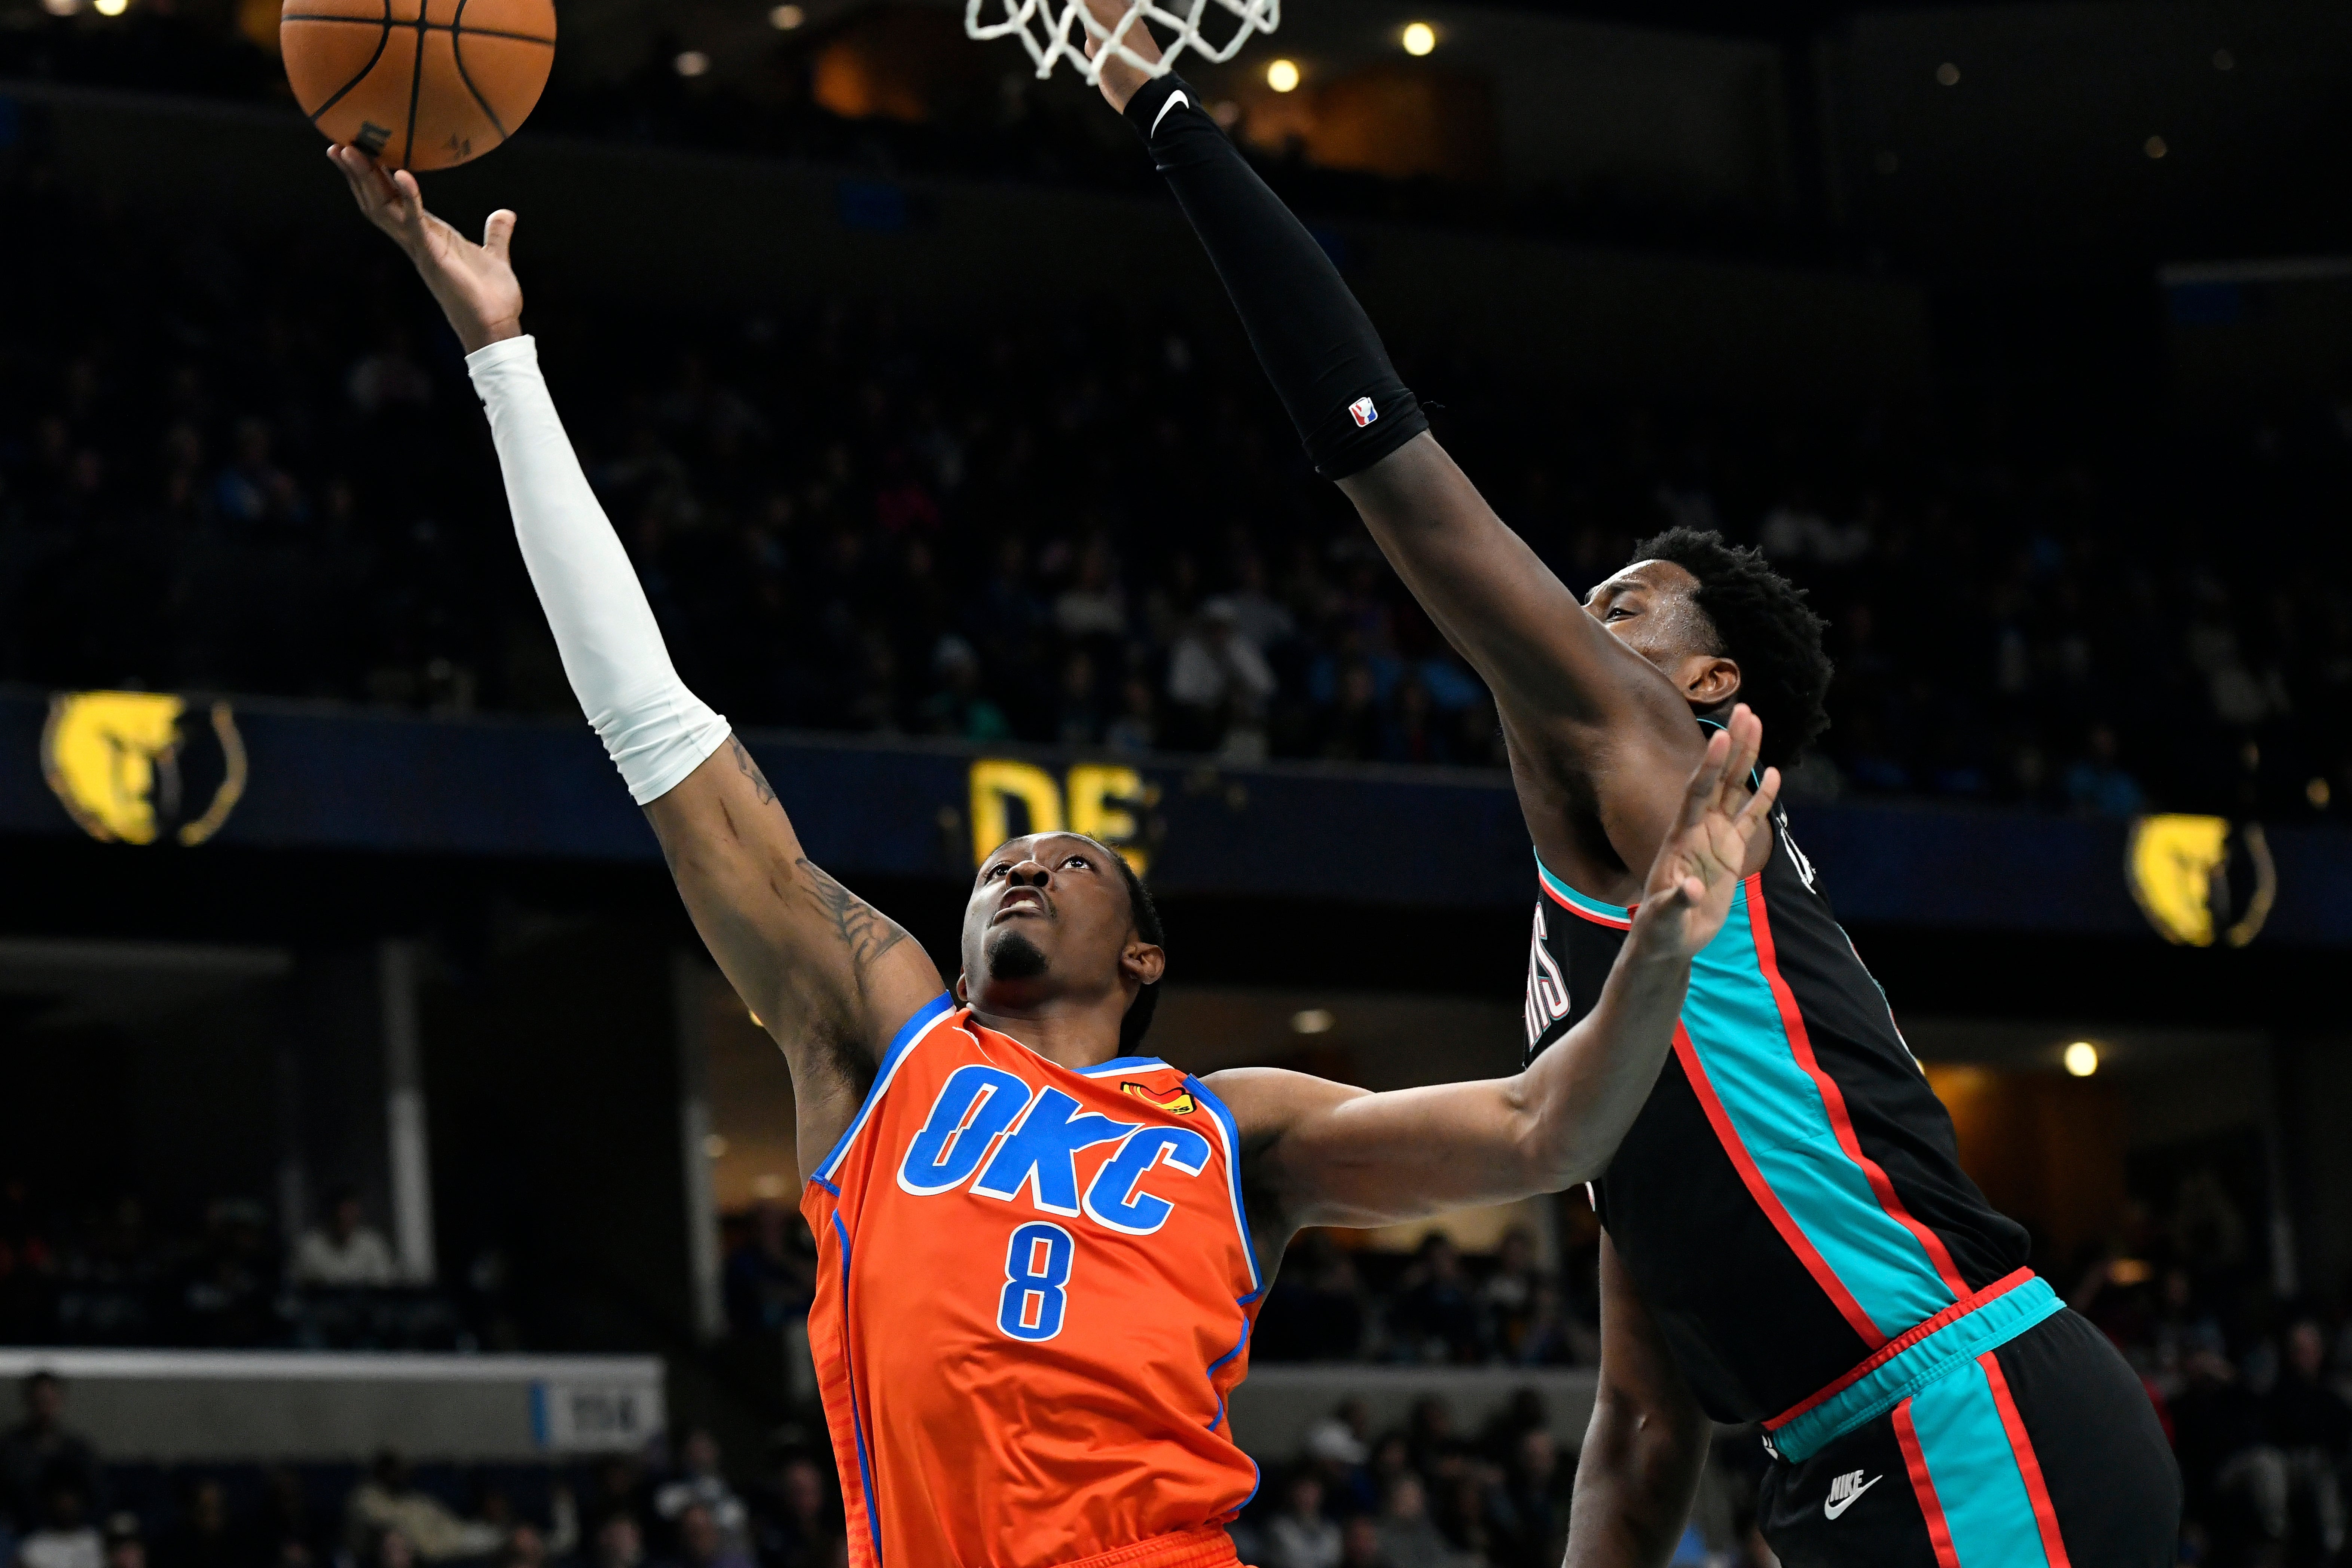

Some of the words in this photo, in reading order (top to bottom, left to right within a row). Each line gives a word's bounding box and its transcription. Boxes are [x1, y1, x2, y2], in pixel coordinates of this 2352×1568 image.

[897, 1064, 1212, 1235] OKC
[996, 1220, 1075, 1342] 8
[1829, 1469, 1864, 1503] NIKE
